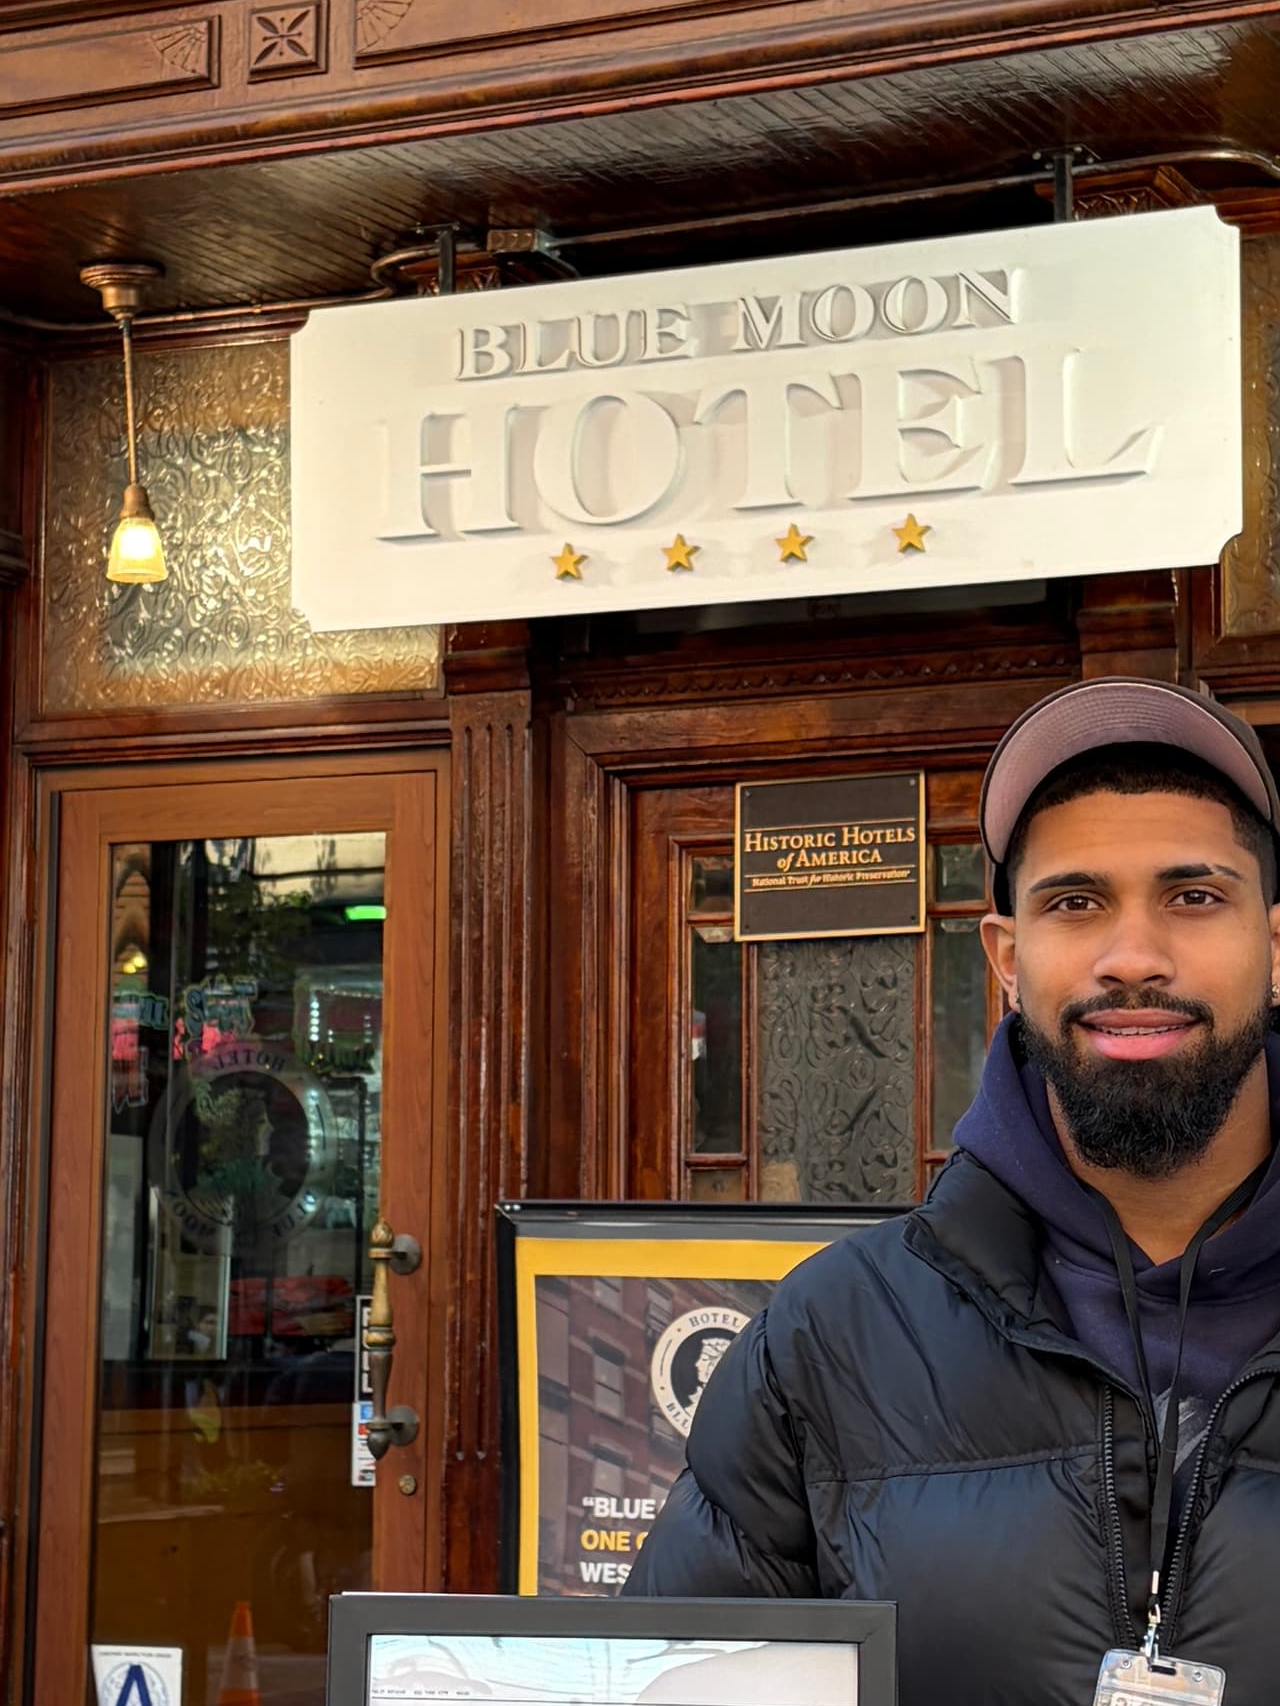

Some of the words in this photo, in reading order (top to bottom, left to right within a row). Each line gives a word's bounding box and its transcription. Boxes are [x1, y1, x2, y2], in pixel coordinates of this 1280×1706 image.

[456, 303, 692, 381] BLUE
[734, 267, 1022, 353] MOON
[376, 346, 1164, 543] HOTEL
[777, 853, 795, 872] of
[795, 848, 883, 868] AMERICA
[752, 876, 787, 888] National
[788, 874, 809, 886] Trust
[808, 873, 822, 887] for
[822, 872, 854, 884] Historic
[689, 1312, 741, 1329] HOTEL
[580, 1529, 631, 1552] ONE
[579, 1561, 632, 1584] WES
